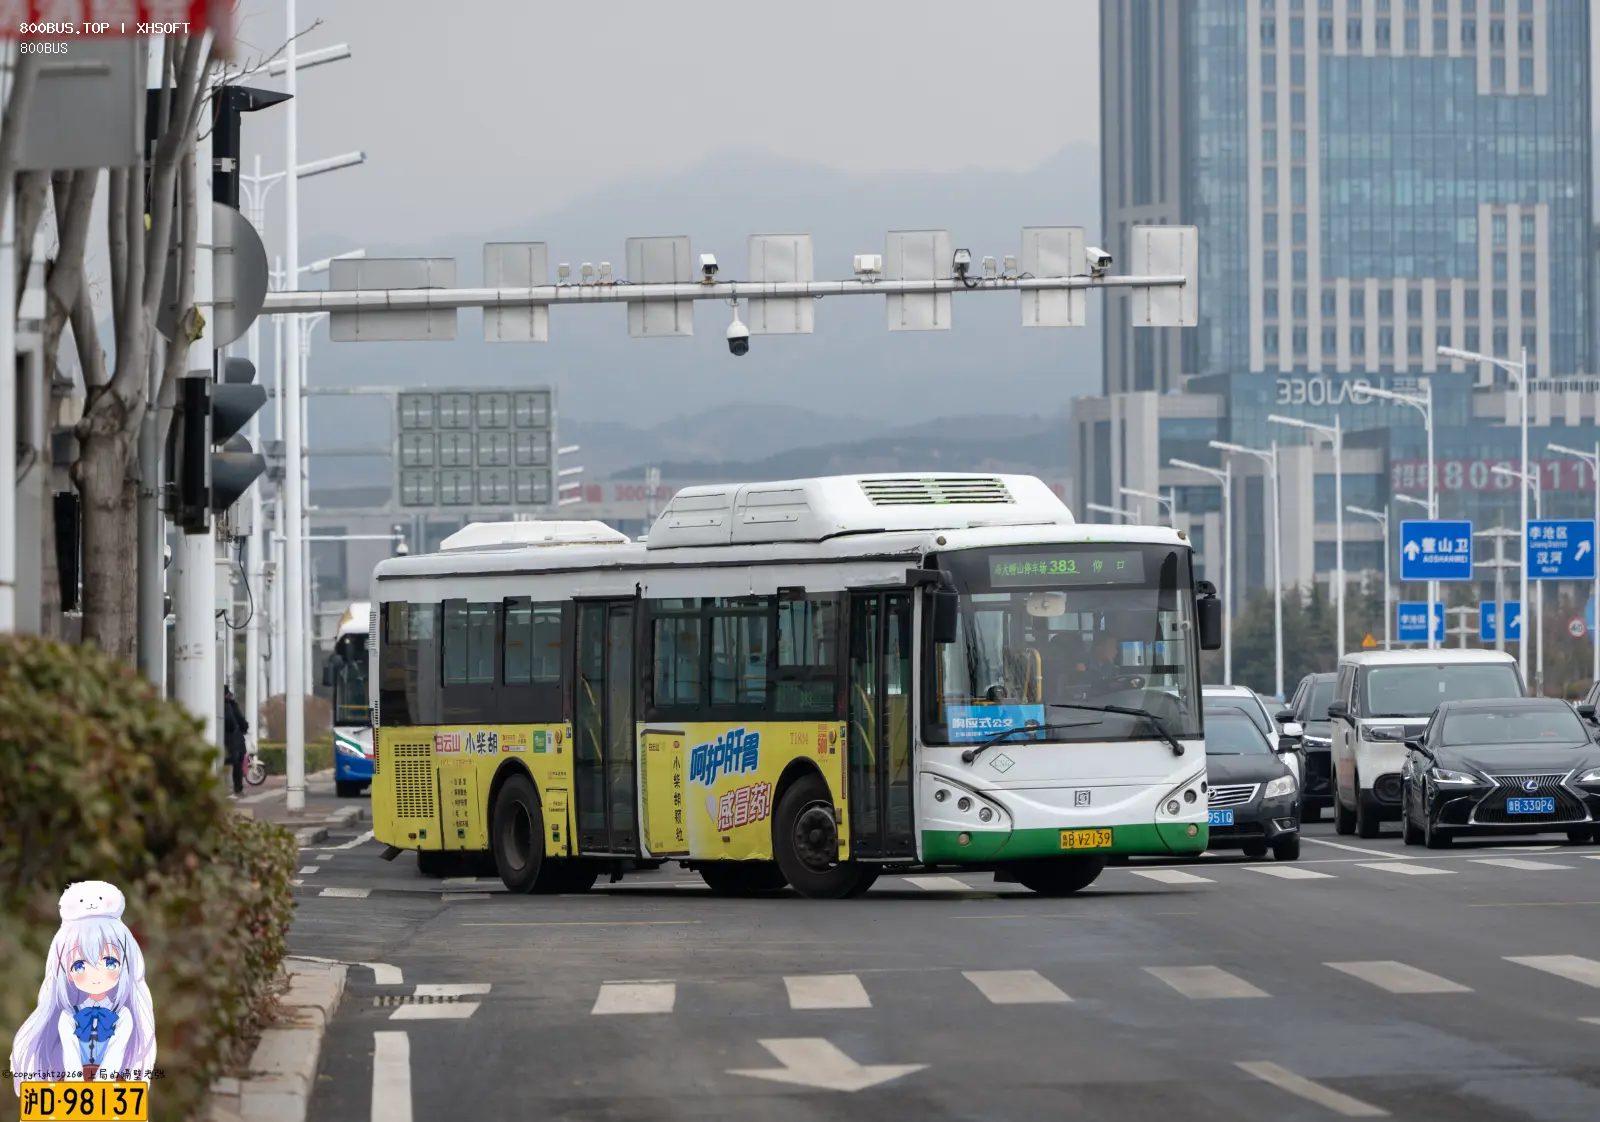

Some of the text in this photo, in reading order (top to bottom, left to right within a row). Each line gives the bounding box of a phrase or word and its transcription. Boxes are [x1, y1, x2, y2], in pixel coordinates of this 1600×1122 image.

[1529, 526, 1568, 540] 李沧区
[1050, 560, 1076, 573] 383
[1536, 552, 1563, 565] 汉河
[952, 717, 1013, 729] 响应式公交
[435, 735, 461, 753] 白云山
[465, 731, 498, 754] 小柴胡
[690, 728, 760, 786] 呵护肝胃
[672, 756, 684, 842] 小柴胡颗粒
[718, 782, 773, 832] 感冒药!
